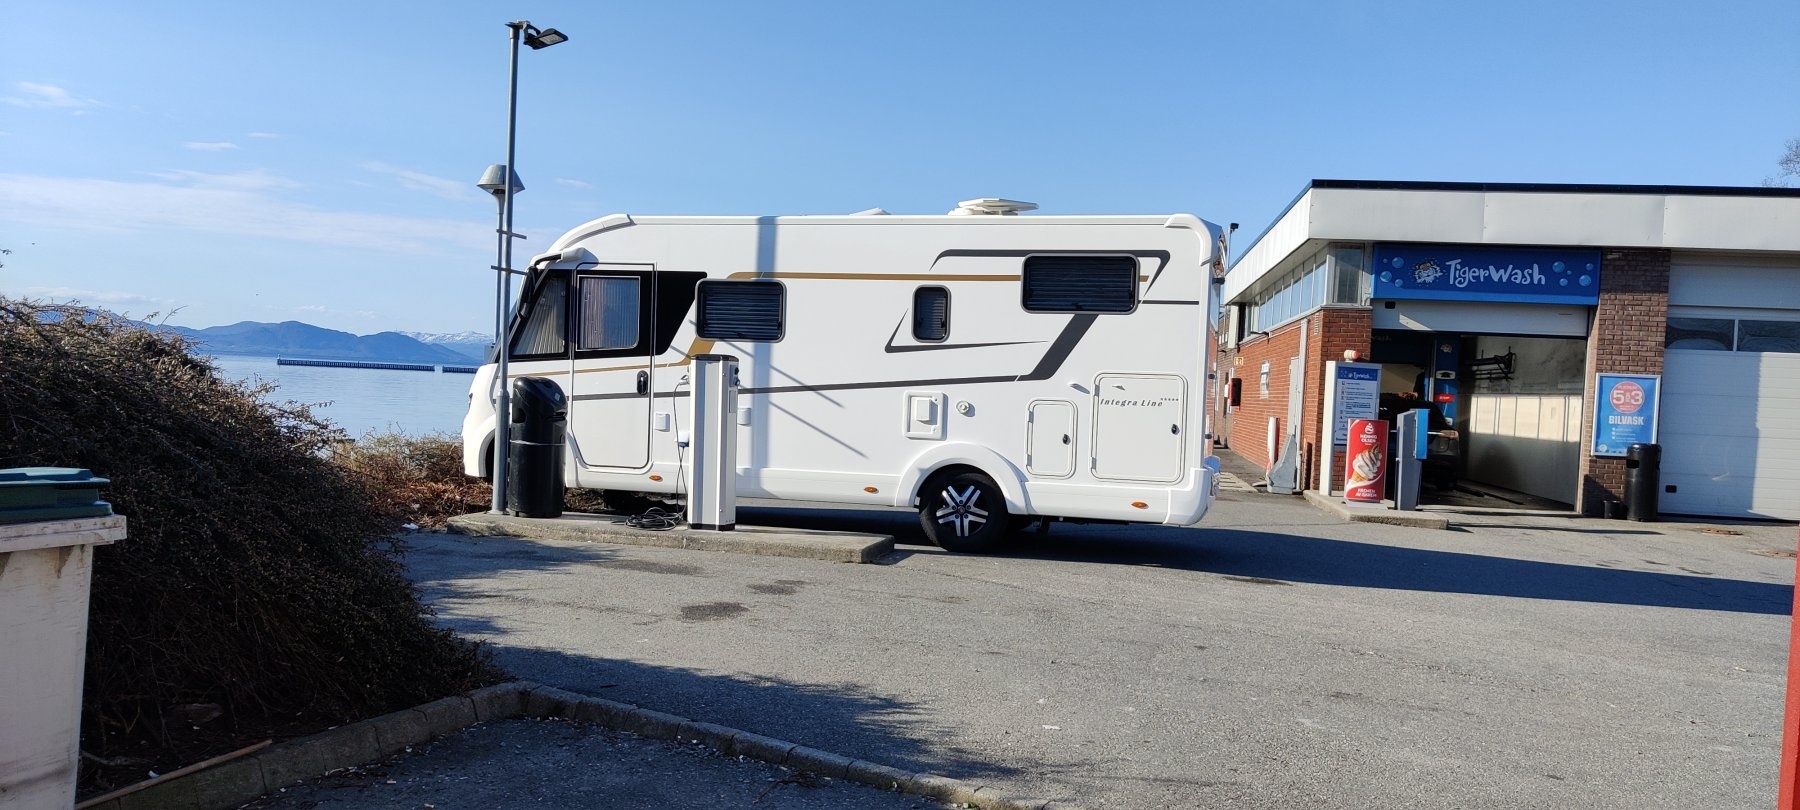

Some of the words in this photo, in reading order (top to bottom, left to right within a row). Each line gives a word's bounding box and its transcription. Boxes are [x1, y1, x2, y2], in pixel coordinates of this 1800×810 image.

[1445, 258, 1546, 288] TigerWash
[1100, 398, 1138, 408] Integra
[1141, 398, 1163, 407] Line
[1612, 390, 1625, 405] 5
[1630, 390, 1643, 405] 3
[1608, 415, 1645, 426] BILVASK
